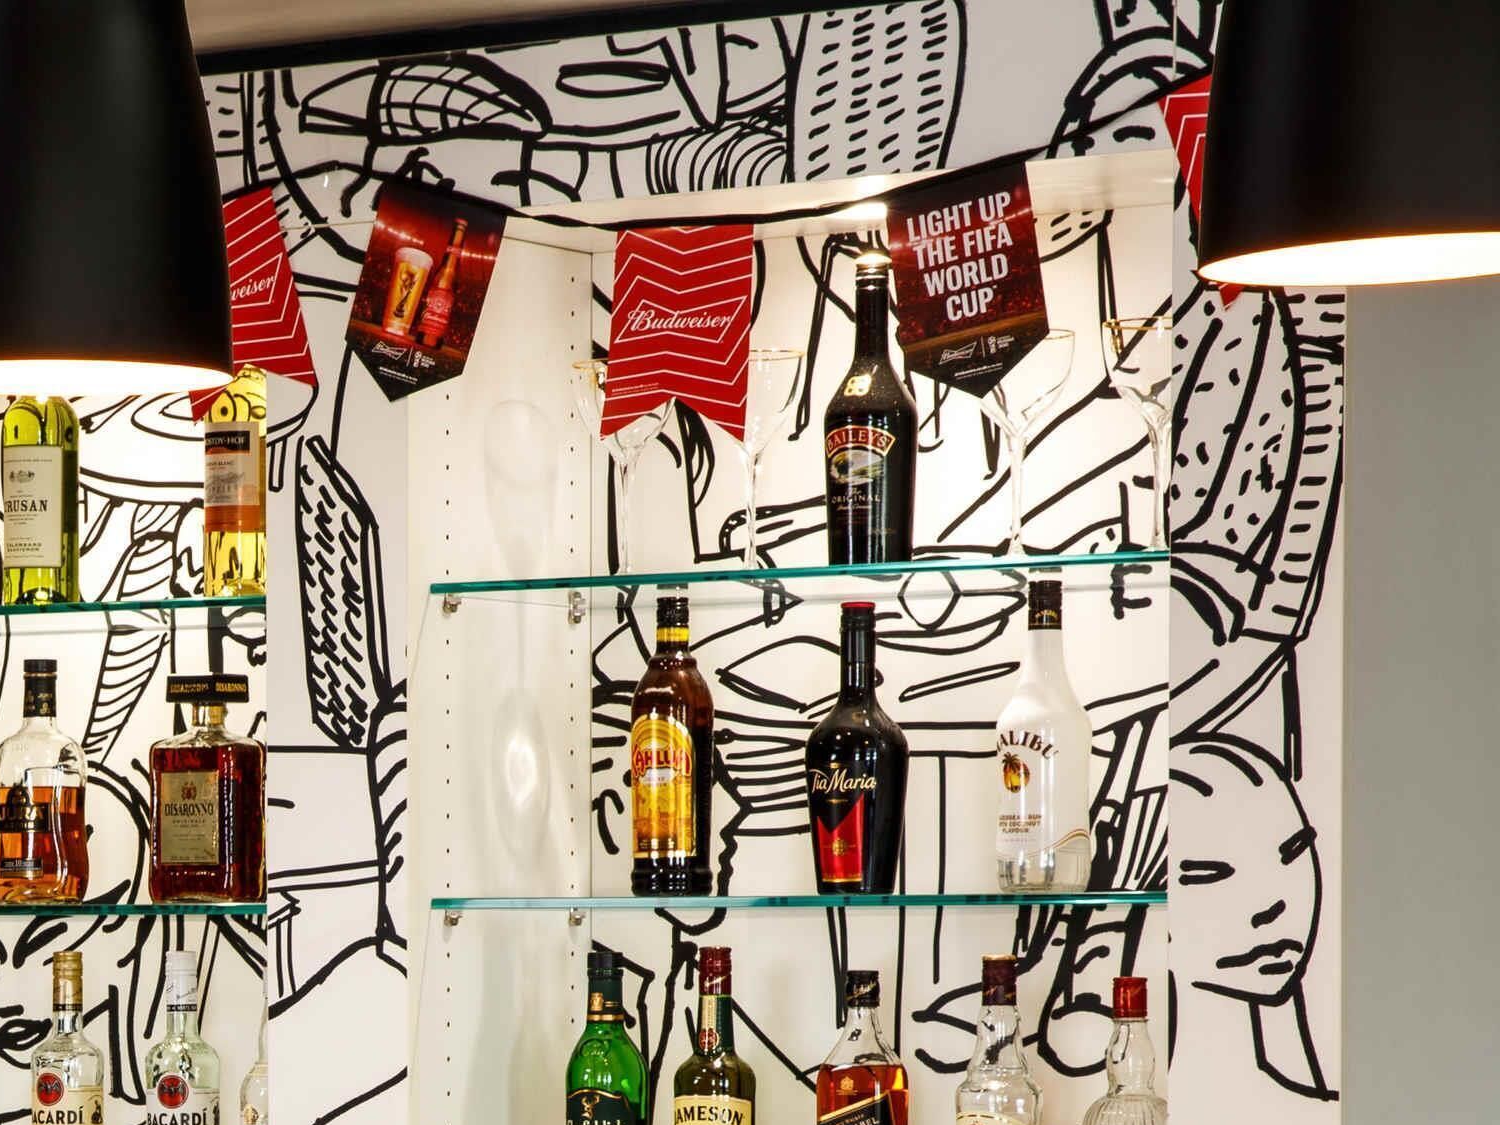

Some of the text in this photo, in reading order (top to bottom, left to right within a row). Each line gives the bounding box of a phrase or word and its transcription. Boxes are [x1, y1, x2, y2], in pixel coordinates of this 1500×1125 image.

[907, 191, 1011, 243] LIGHT UP
[913, 222, 1013, 270] THE FIFA
[924, 254, 1008, 297] WORLD
[231, 276, 275, 300] weiser
[946, 286, 997, 320] CUP
[628, 309, 732, 331] Budweiser
[4, 499, 48, 513] RUSAN
[996, 730, 1059, 759] ALIBU
[810, 769, 876, 793] Tia Maria
[165, 802, 214, 816] DISARONNO
[32, 1106, 83, 1125] ACARDÍ
